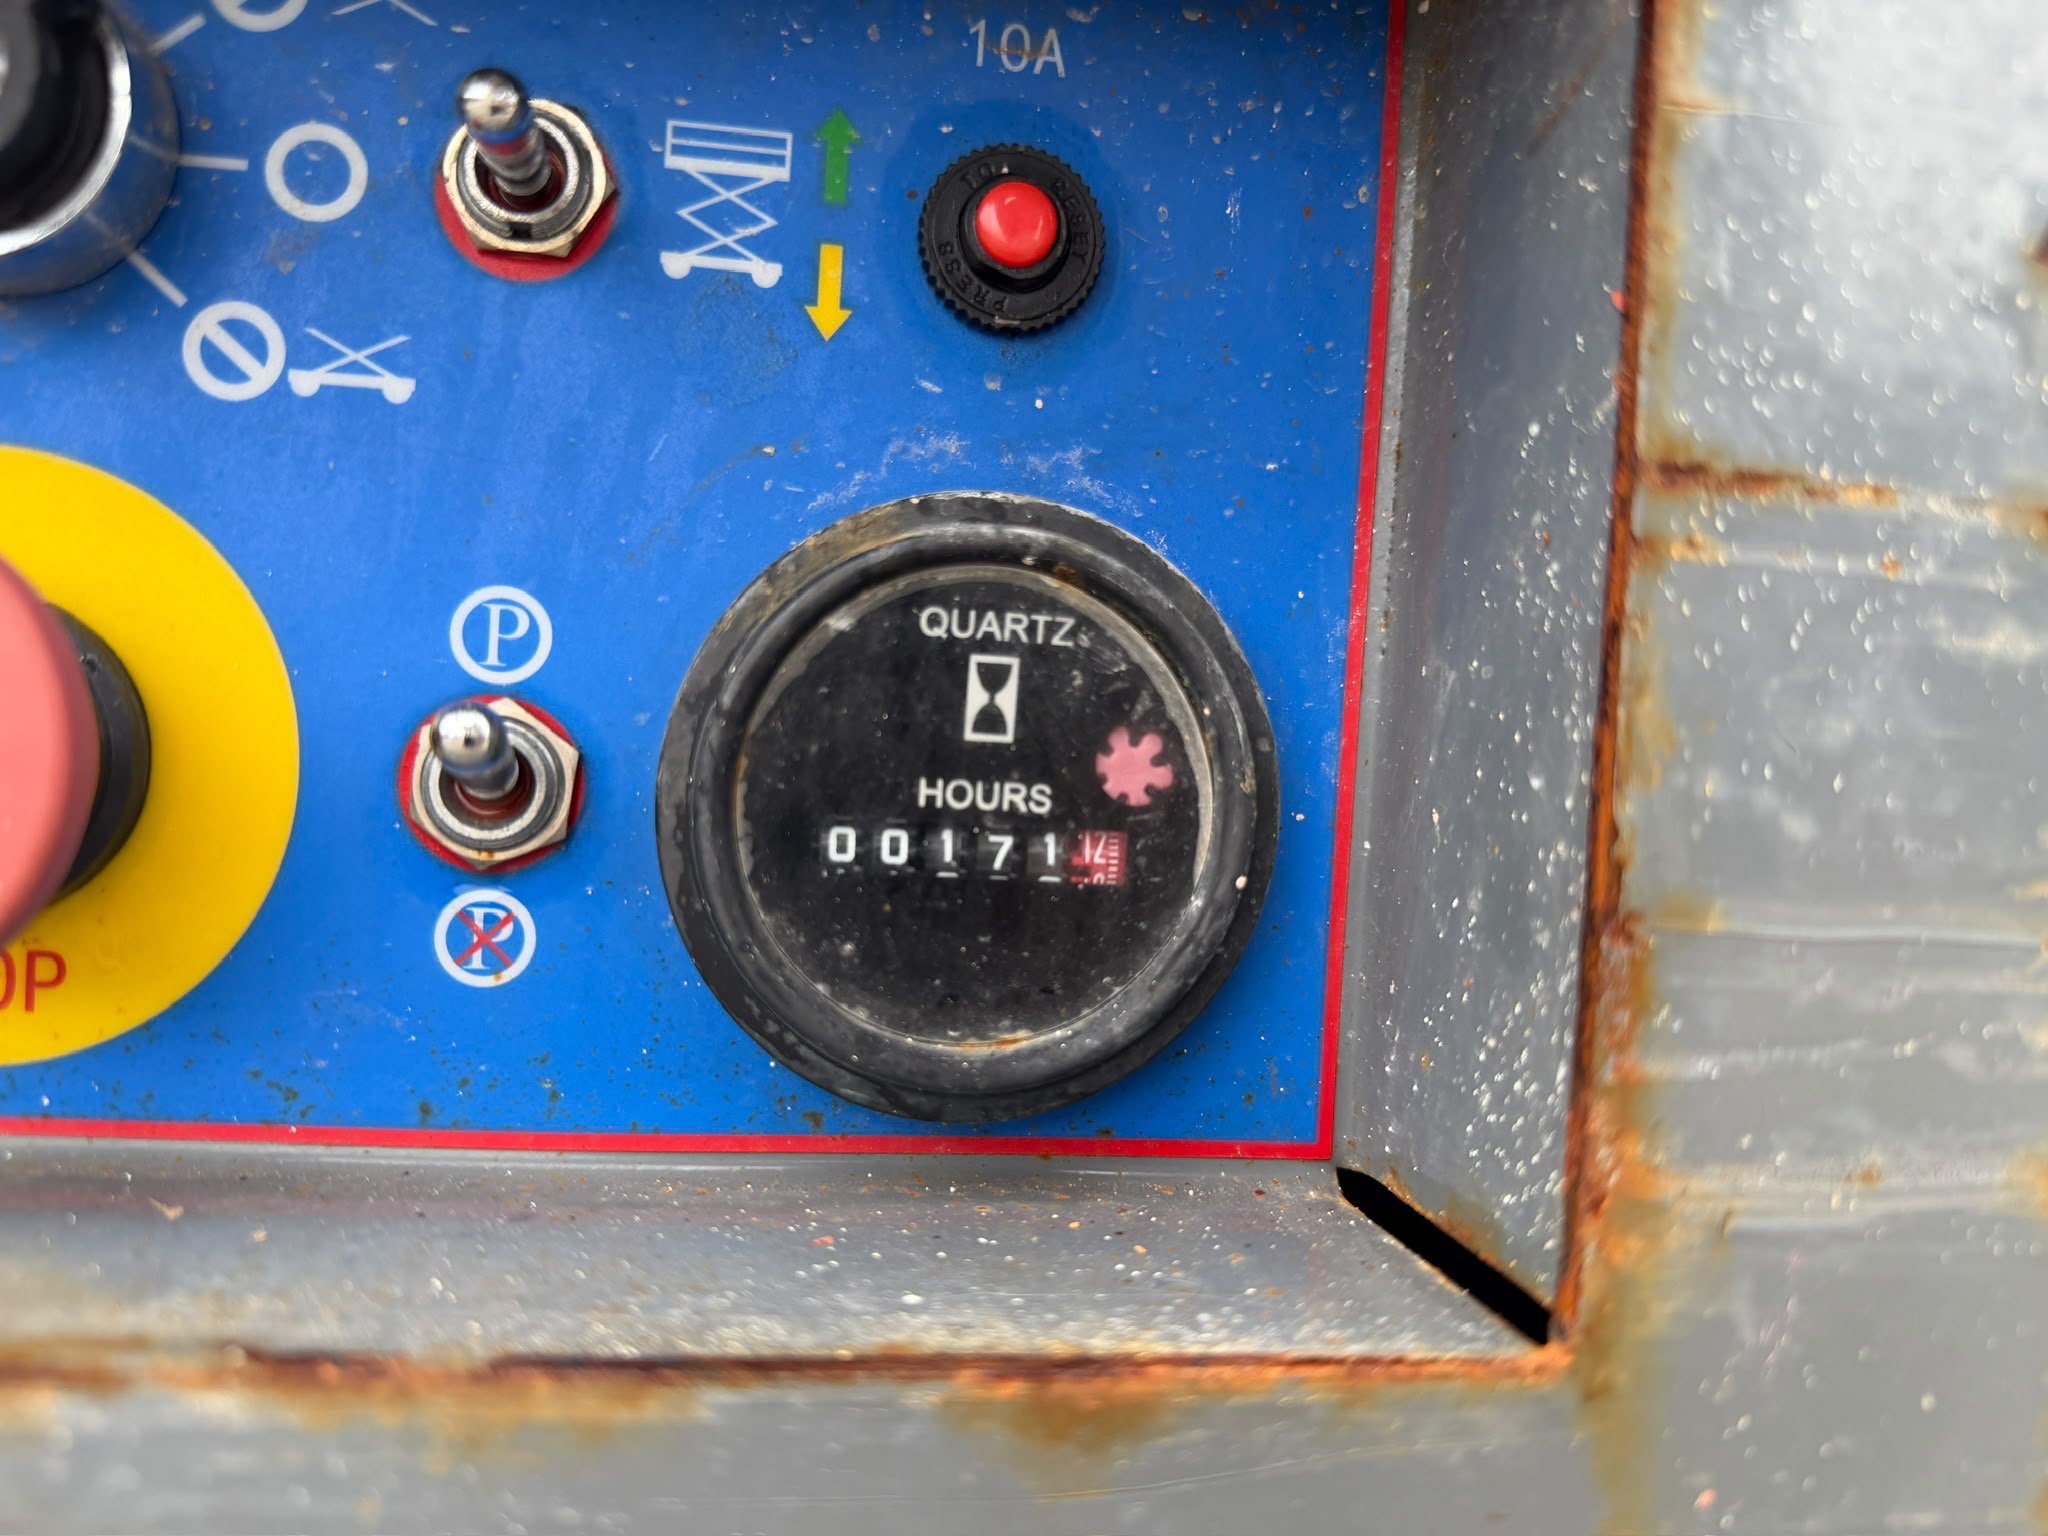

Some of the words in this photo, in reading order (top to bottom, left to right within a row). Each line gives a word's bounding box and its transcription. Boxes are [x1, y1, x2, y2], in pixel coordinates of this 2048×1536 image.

[969, 19, 1066, 78] 10A
[938, 240, 1009, 314] PRESS
[1051, 177, 1089, 265] RESET
[478, 603, 530, 667] P
[919, 606, 1077, 648] QUARTZ
[917, 777, 1053, 814] HOURS
